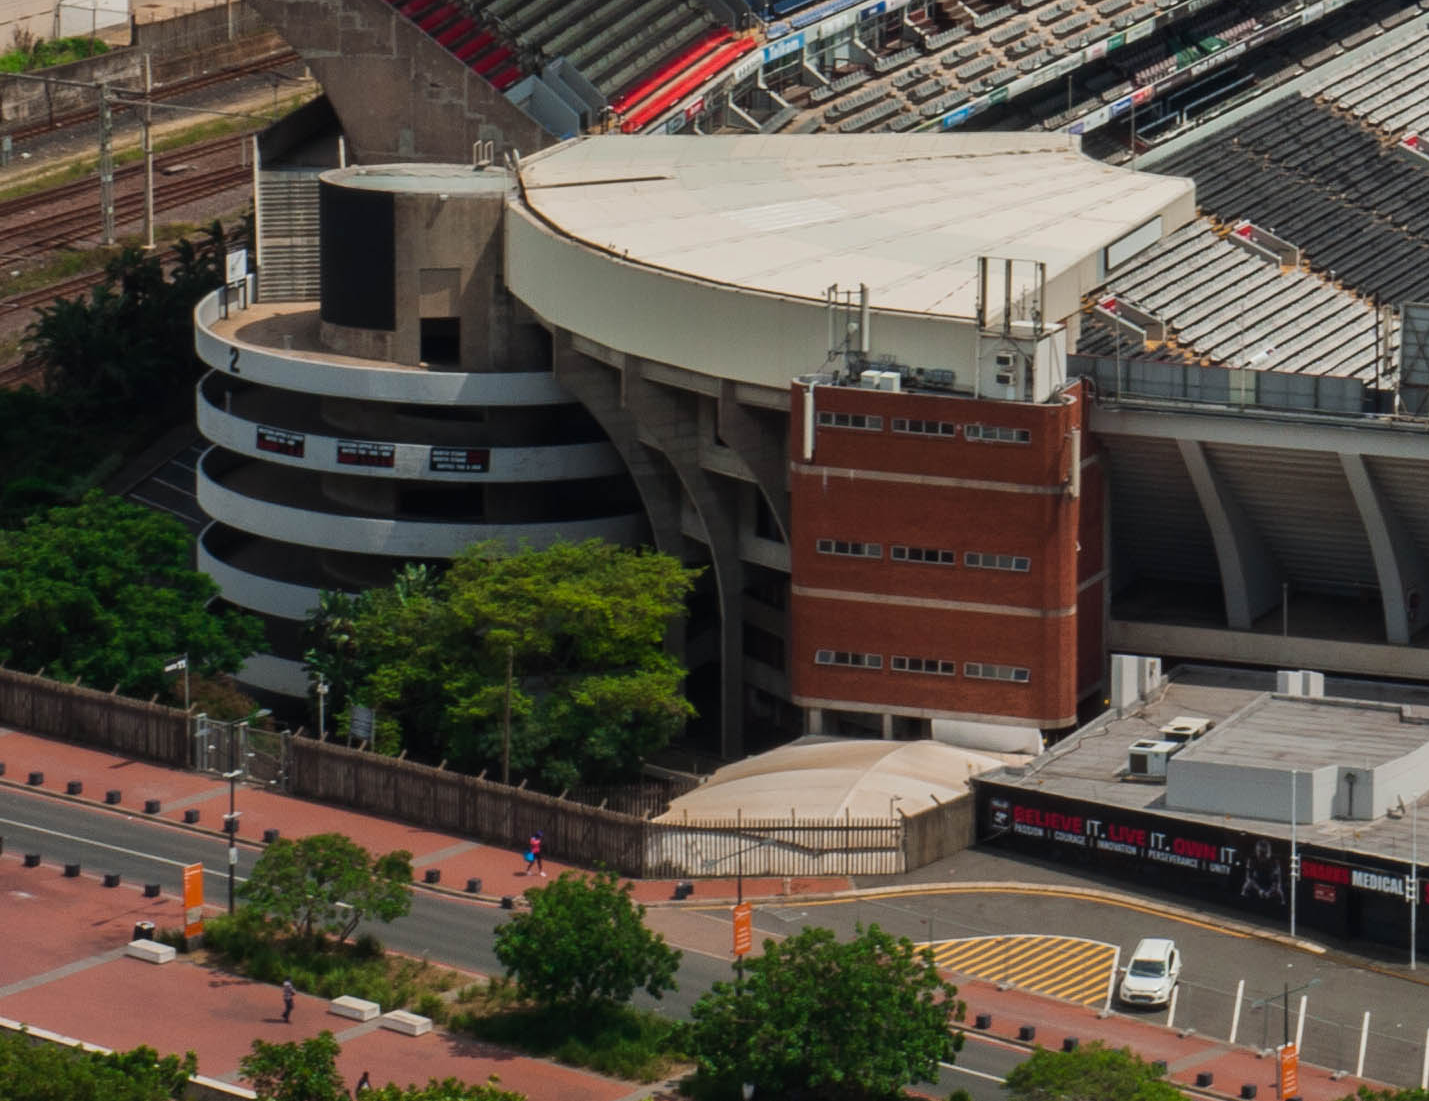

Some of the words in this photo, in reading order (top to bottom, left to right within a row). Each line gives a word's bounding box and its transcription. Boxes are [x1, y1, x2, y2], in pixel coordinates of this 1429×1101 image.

[228, 346, 241, 373] 2
[1013, 806, 1082, 833] BELIEVE
[1087, 820, 1105, 838] IT.
[1109, 823, 1146, 846] LIVE
[1151, 833, 1170, 850] IT.
[1173, 838, 1217, 860] OWN
[1221, 846, 1241, 866] IT.
[1055, 831, 1086, 845] COURAGE
[1148, 850, 1198, 869] PERSEVERANCE
[1210, 864, 1231, 875] UNITY
[1352, 870, 1404, 895] MEDICAL
